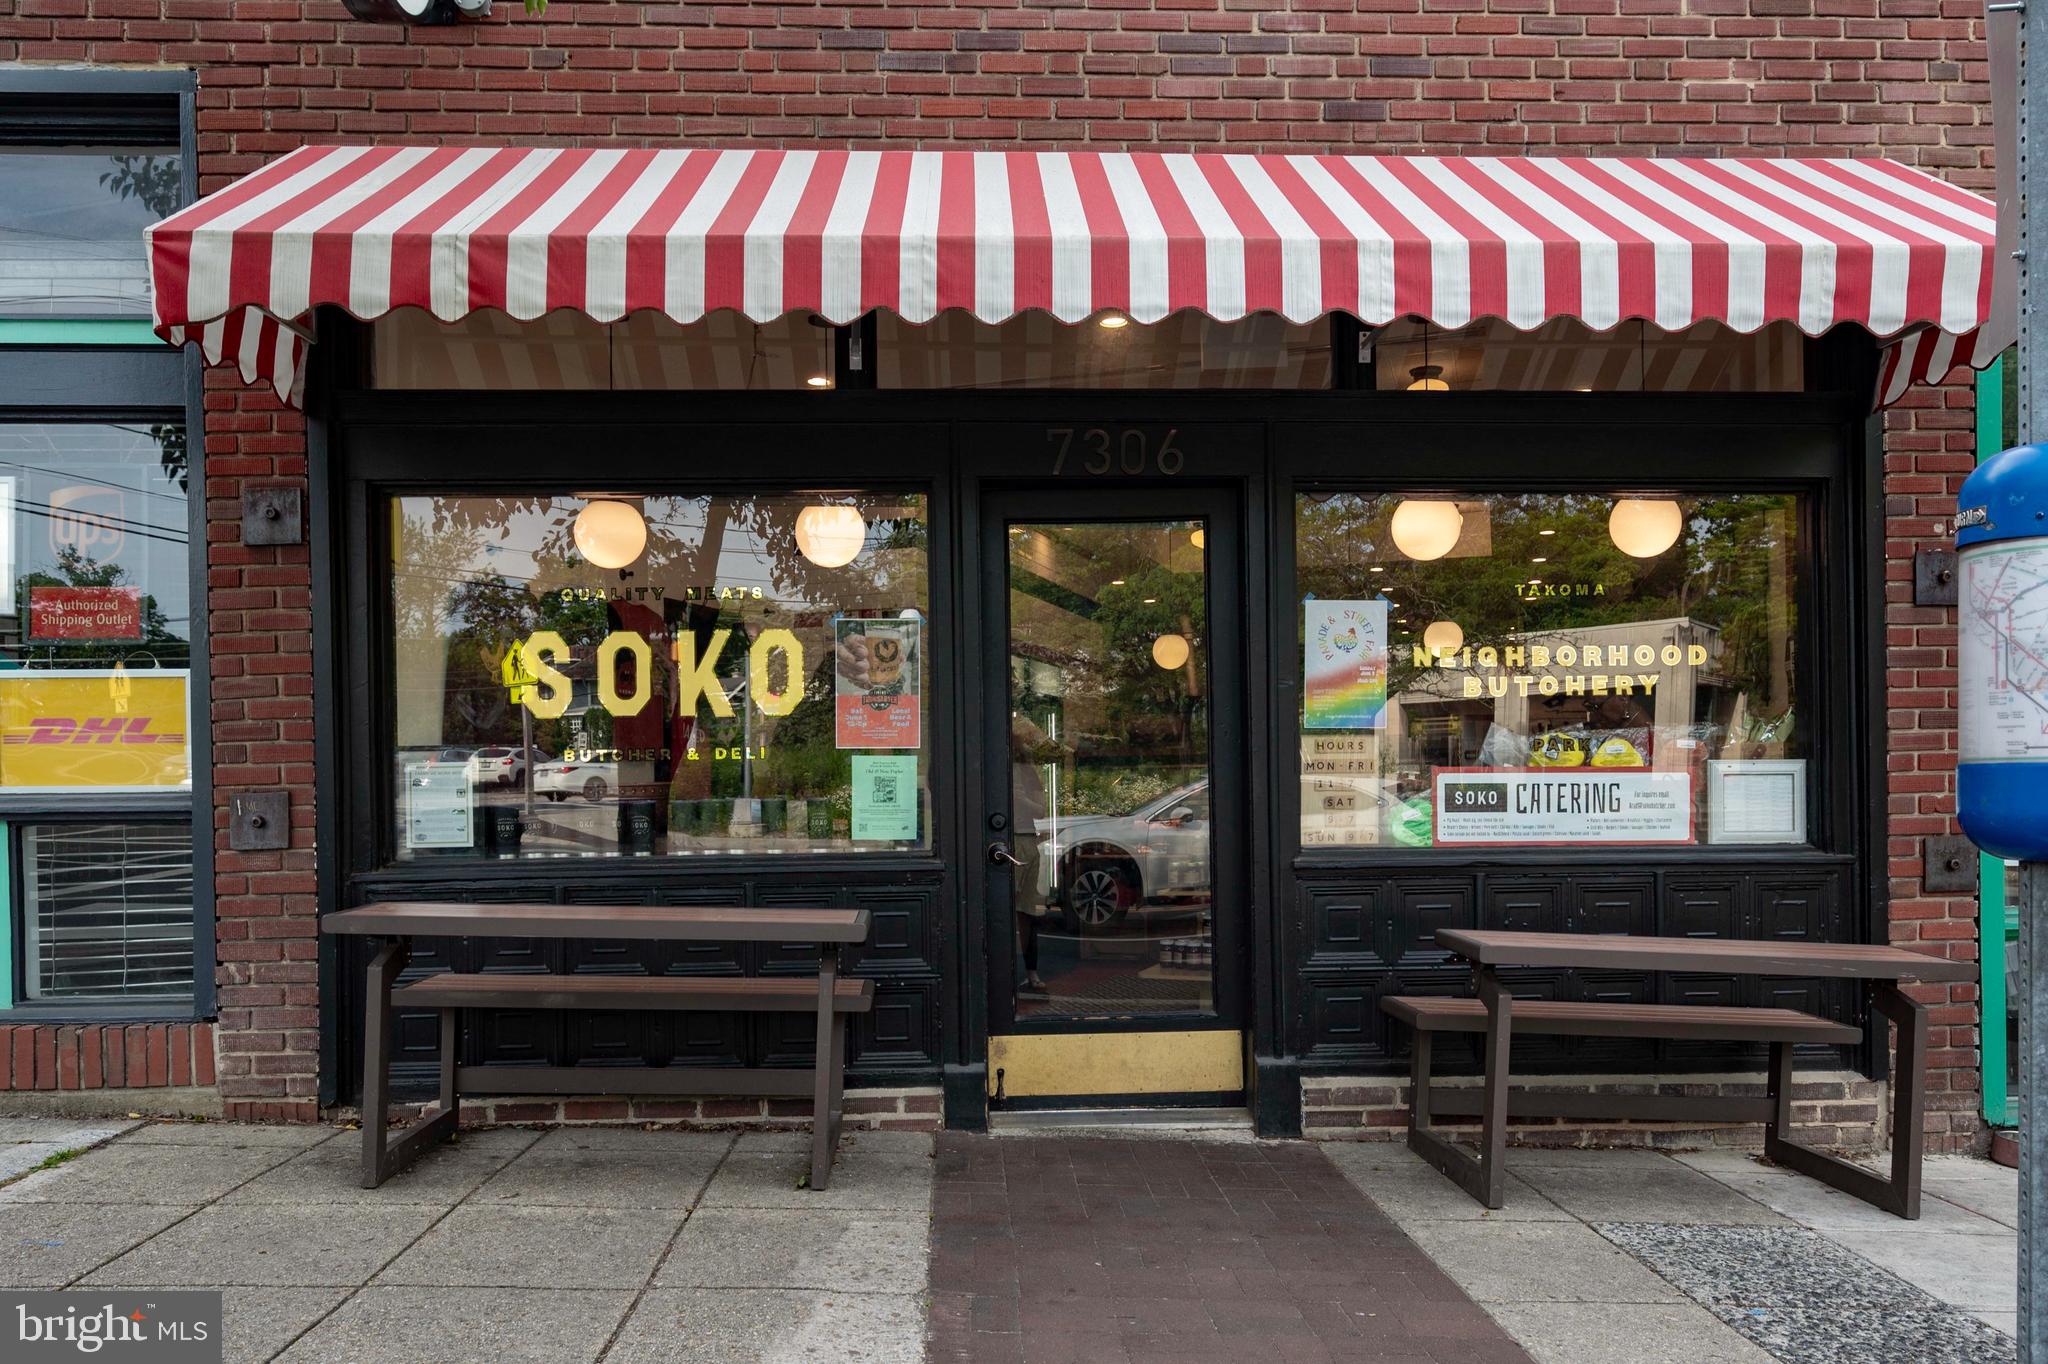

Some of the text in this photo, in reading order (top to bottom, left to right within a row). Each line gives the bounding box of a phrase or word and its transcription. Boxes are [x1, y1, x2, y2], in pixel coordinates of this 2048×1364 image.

[1047, 428, 1184, 475] 7306
[55, 511, 119, 557] ups
[561, 586, 764, 601] QUALITY MEATS
[1515, 584, 1605, 596] TAKOMA
[55, 600, 119, 611] Authorized
[41, 614, 132, 627] Shipping Outlet
[1413, 644, 1708, 668] NEIGHBORHOOD
[521, 628, 804, 719] SOKO
[1463, 674, 1660, 698] BUTCHERY
[27, 717, 160, 745] DHL
[1316, 741, 1364, 750] HOURS
[1533, 738, 1593, 751] PARK
[564, 746, 765, 763] BUTCHER & DELI
[1327, 798, 1354, 807] SAT
[1455, 783, 1620, 813] SOKO CATERING
[1308, 833, 1335, 841] SUN
